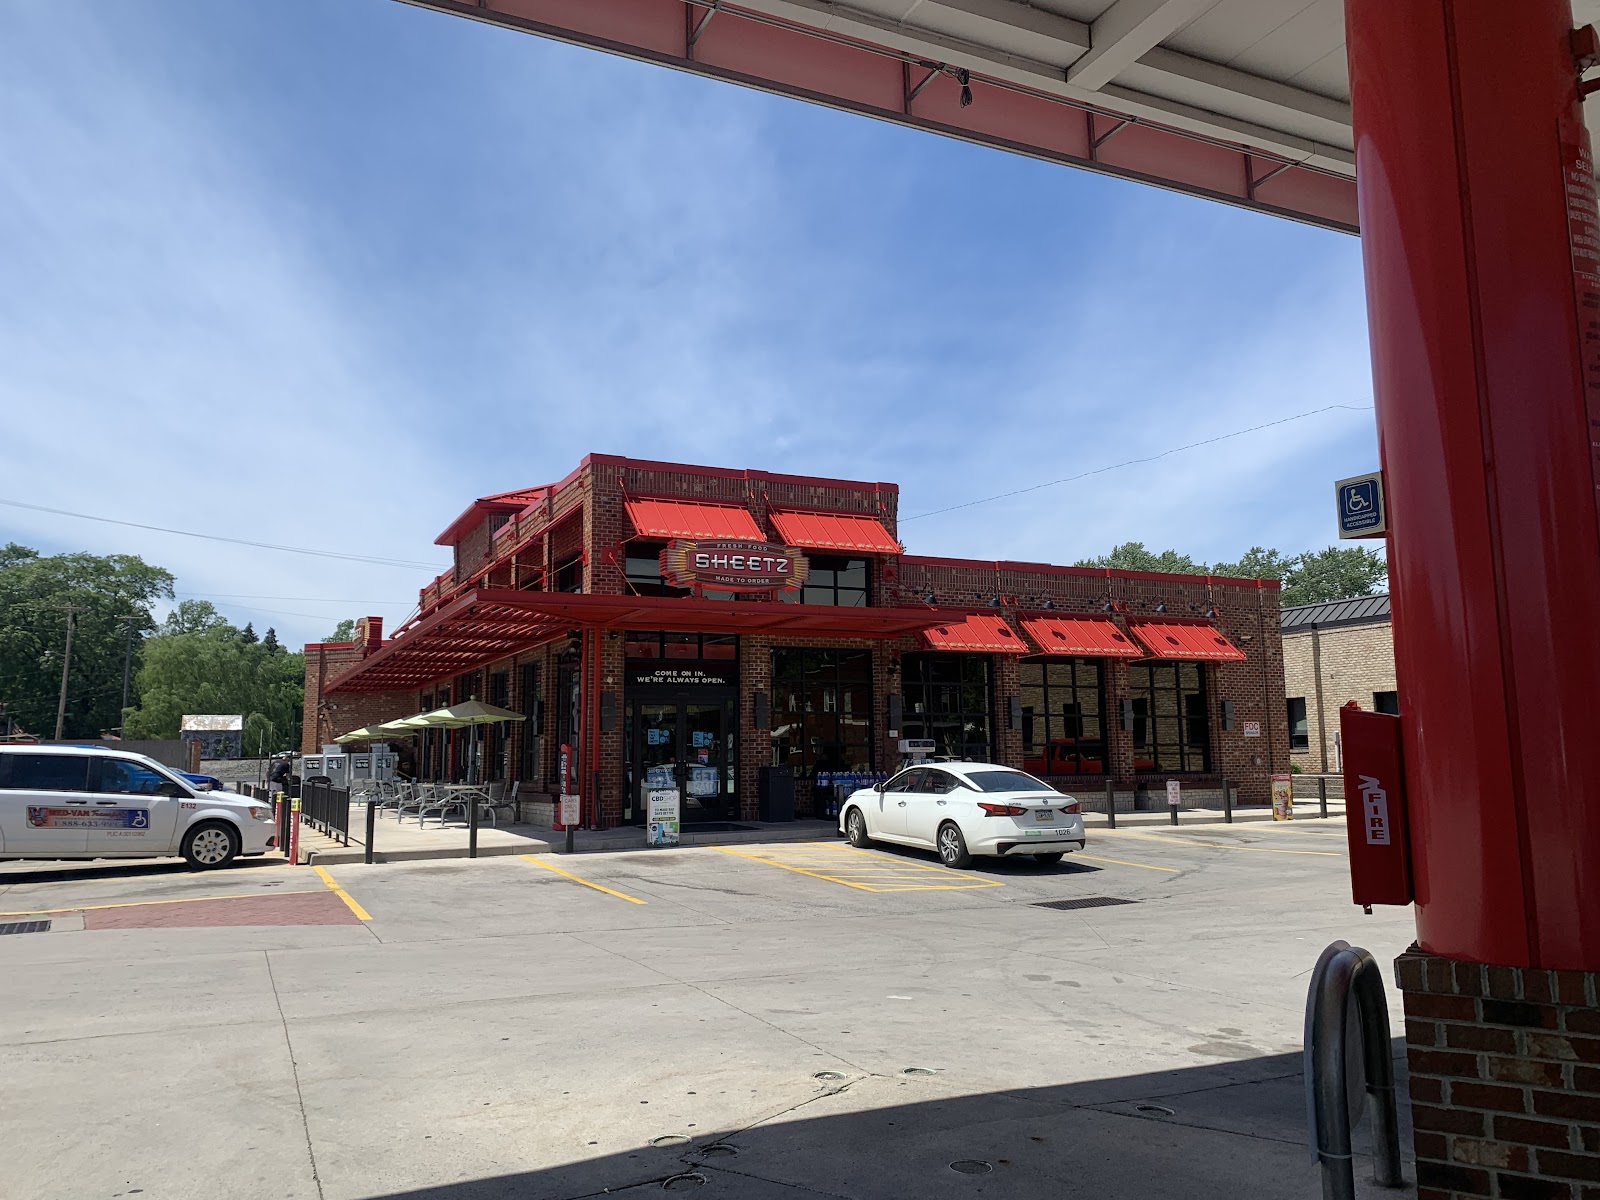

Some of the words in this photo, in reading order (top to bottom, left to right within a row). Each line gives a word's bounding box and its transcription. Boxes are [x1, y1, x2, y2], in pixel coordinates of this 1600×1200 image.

[1344, 512, 1377, 522] HANDICAPPED
[1346, 518, 1376, 528] ACCESSIBLE
[748, 544, 768, 552] FOOD
[695, 554, 788, 572] SHEETZ
[692, 770, 716, 782] GET
[1368, 793, 1384, 840] FIRE
